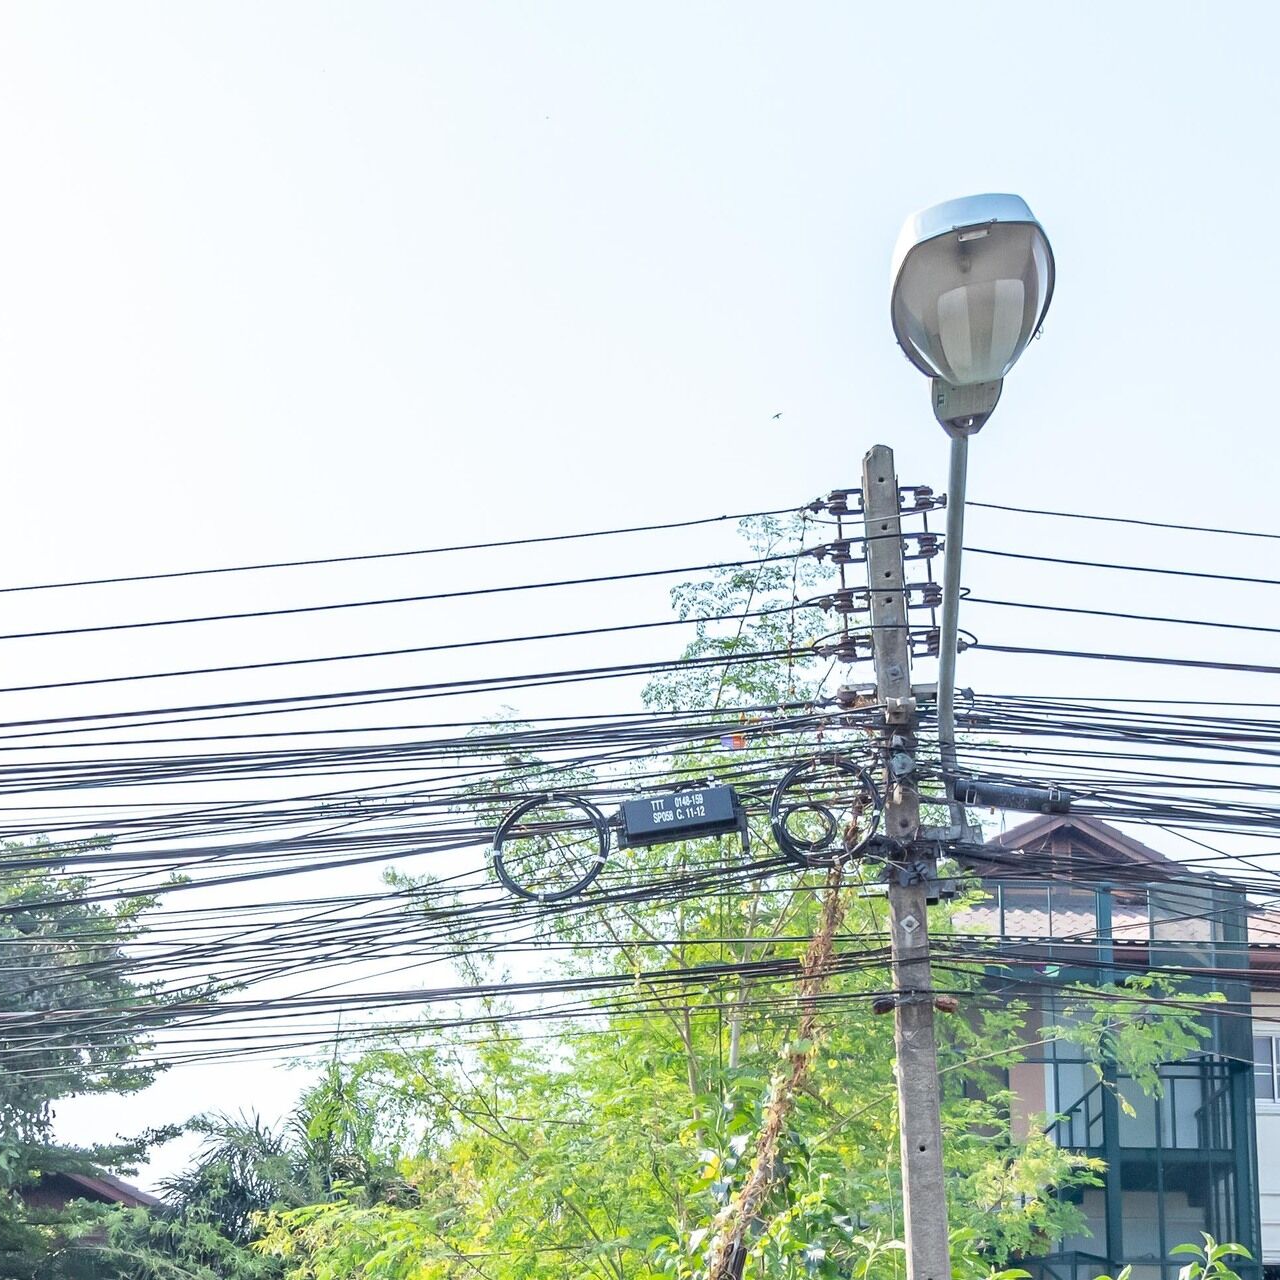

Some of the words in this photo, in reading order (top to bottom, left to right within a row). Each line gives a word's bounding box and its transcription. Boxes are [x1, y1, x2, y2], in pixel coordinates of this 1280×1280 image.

[651, 799, 664, 811] TTT
[674, 794, 704, 808] 0148-159
[686, 806, 706, 818] 11-12
